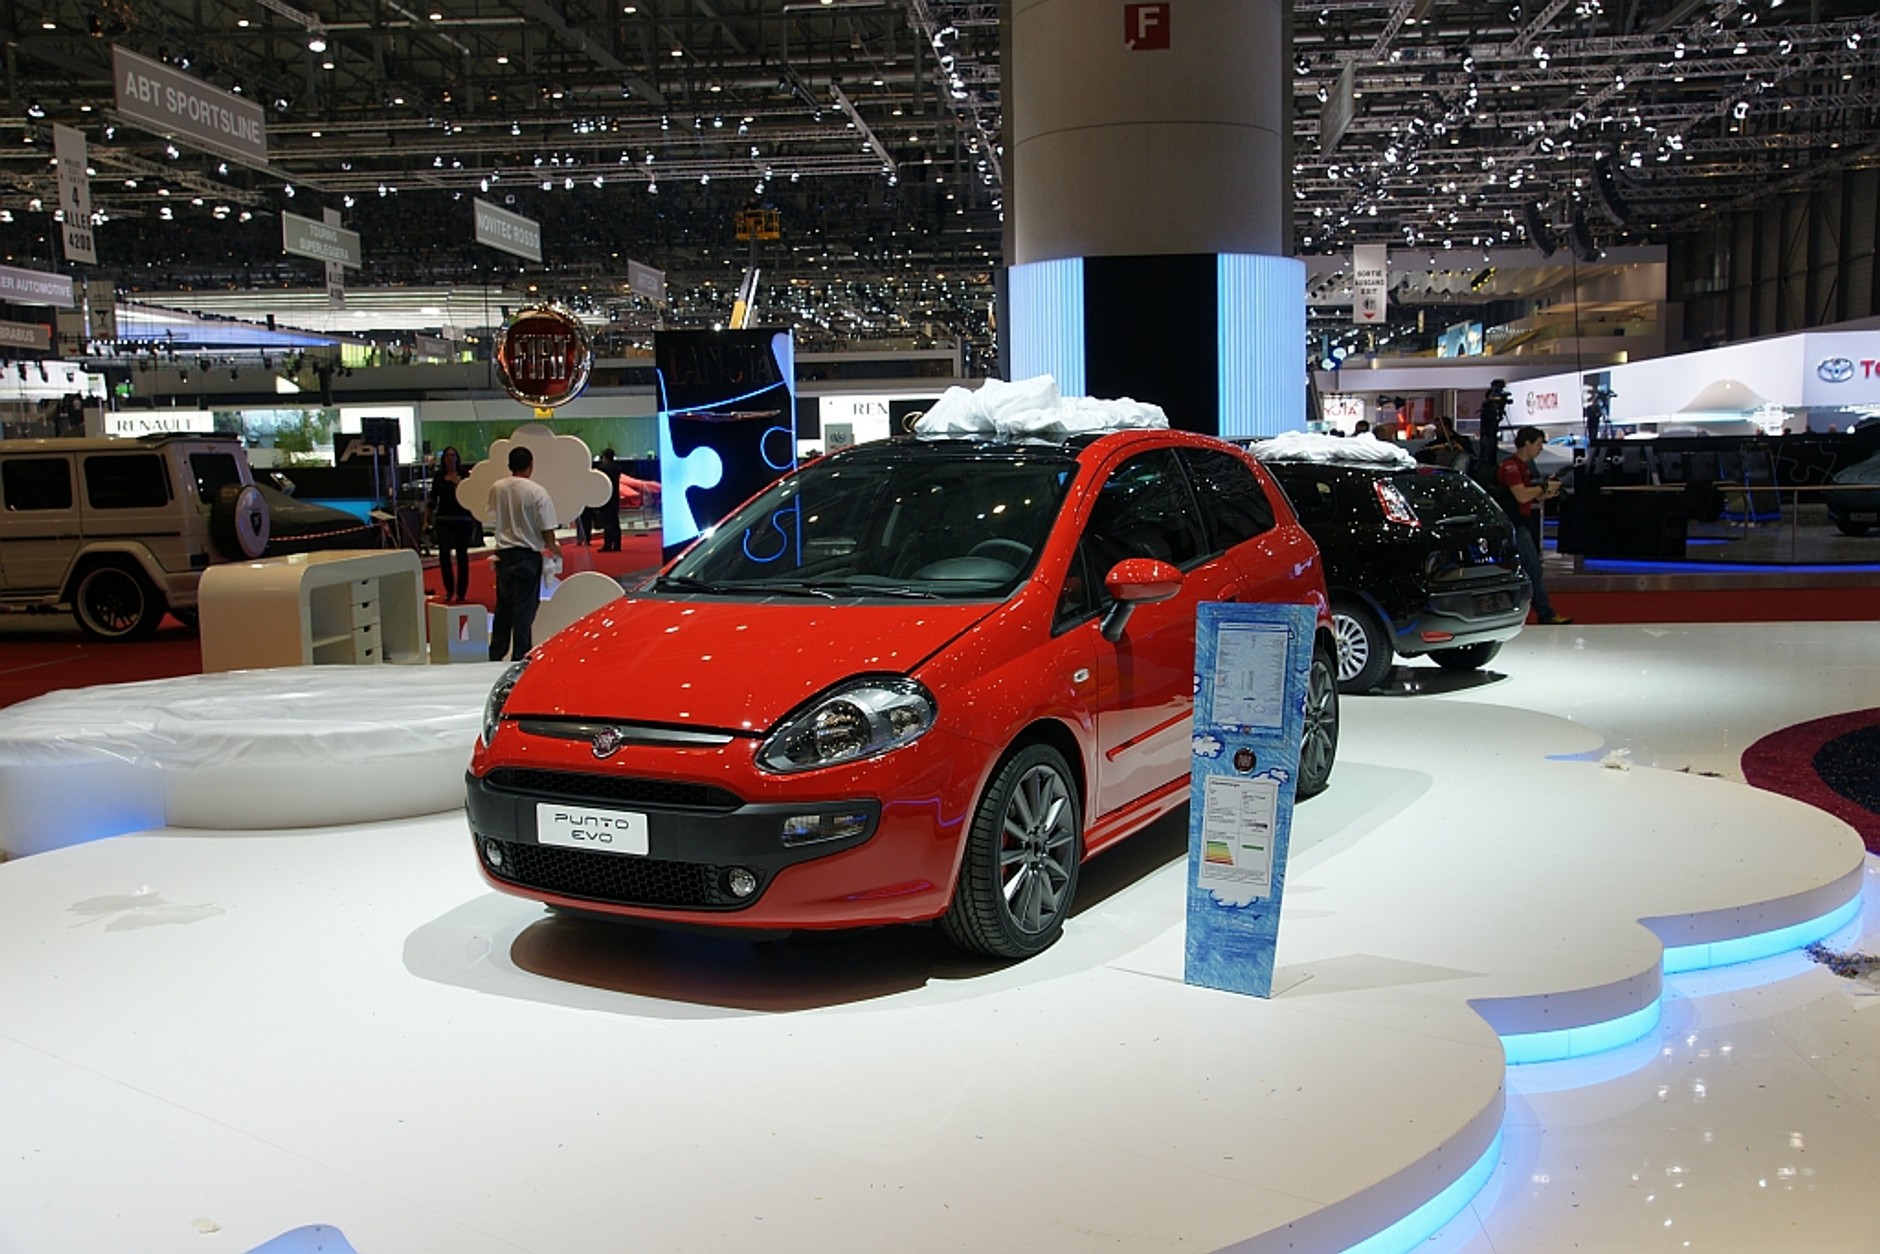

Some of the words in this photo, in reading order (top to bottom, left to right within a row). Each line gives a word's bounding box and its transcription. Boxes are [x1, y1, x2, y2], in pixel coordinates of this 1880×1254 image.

[1138, 6, 1160, 39] F
[125, 71, 161, 107] ABT
[165, 86, 261, 145] SPORTSLINE
[477, 212, 512, 241] NOVITEC
[513, 226, 539, 249] ROSSO
[17, 279, 72, 297] AUTOMOTIVE
[514, 333, 571, 380] FIAT
[1535, 392, 1559, 410] TOYOTA
[116, 419, 194, 432] RENAULT
[554, 813, 629, 830] PUNTO
[571, 830, 612, 843] EVO
